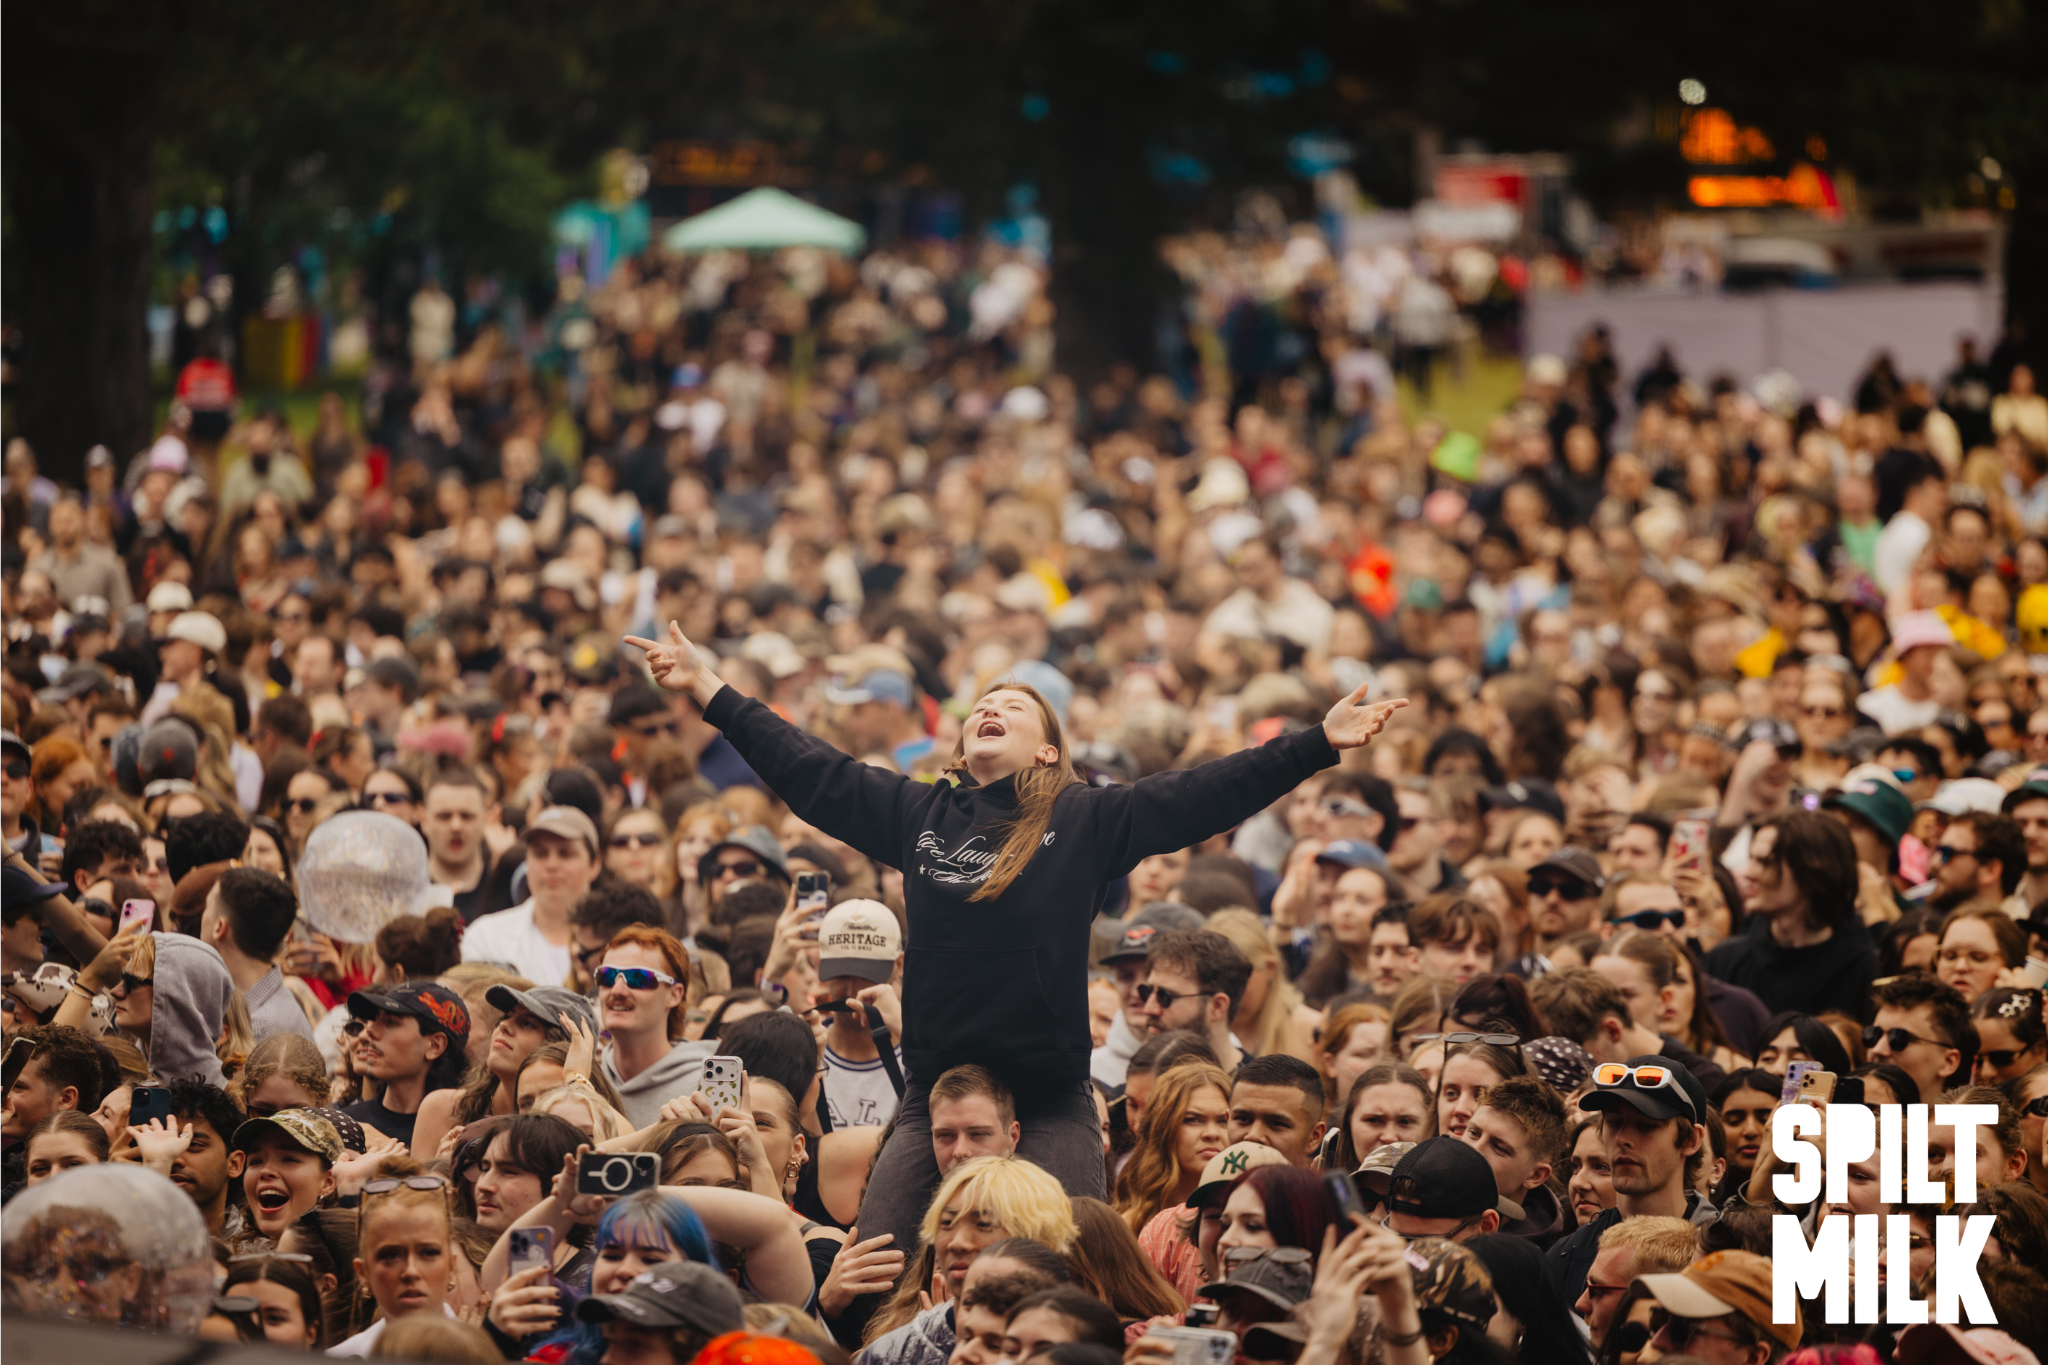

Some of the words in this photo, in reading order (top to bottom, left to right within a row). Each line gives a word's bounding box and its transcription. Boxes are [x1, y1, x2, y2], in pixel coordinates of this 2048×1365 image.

[936, 835, 1001, 874] Laug
[828, 933, 887, 947] HERITAGE
[1220, 1150, 1249, 1174] NY
